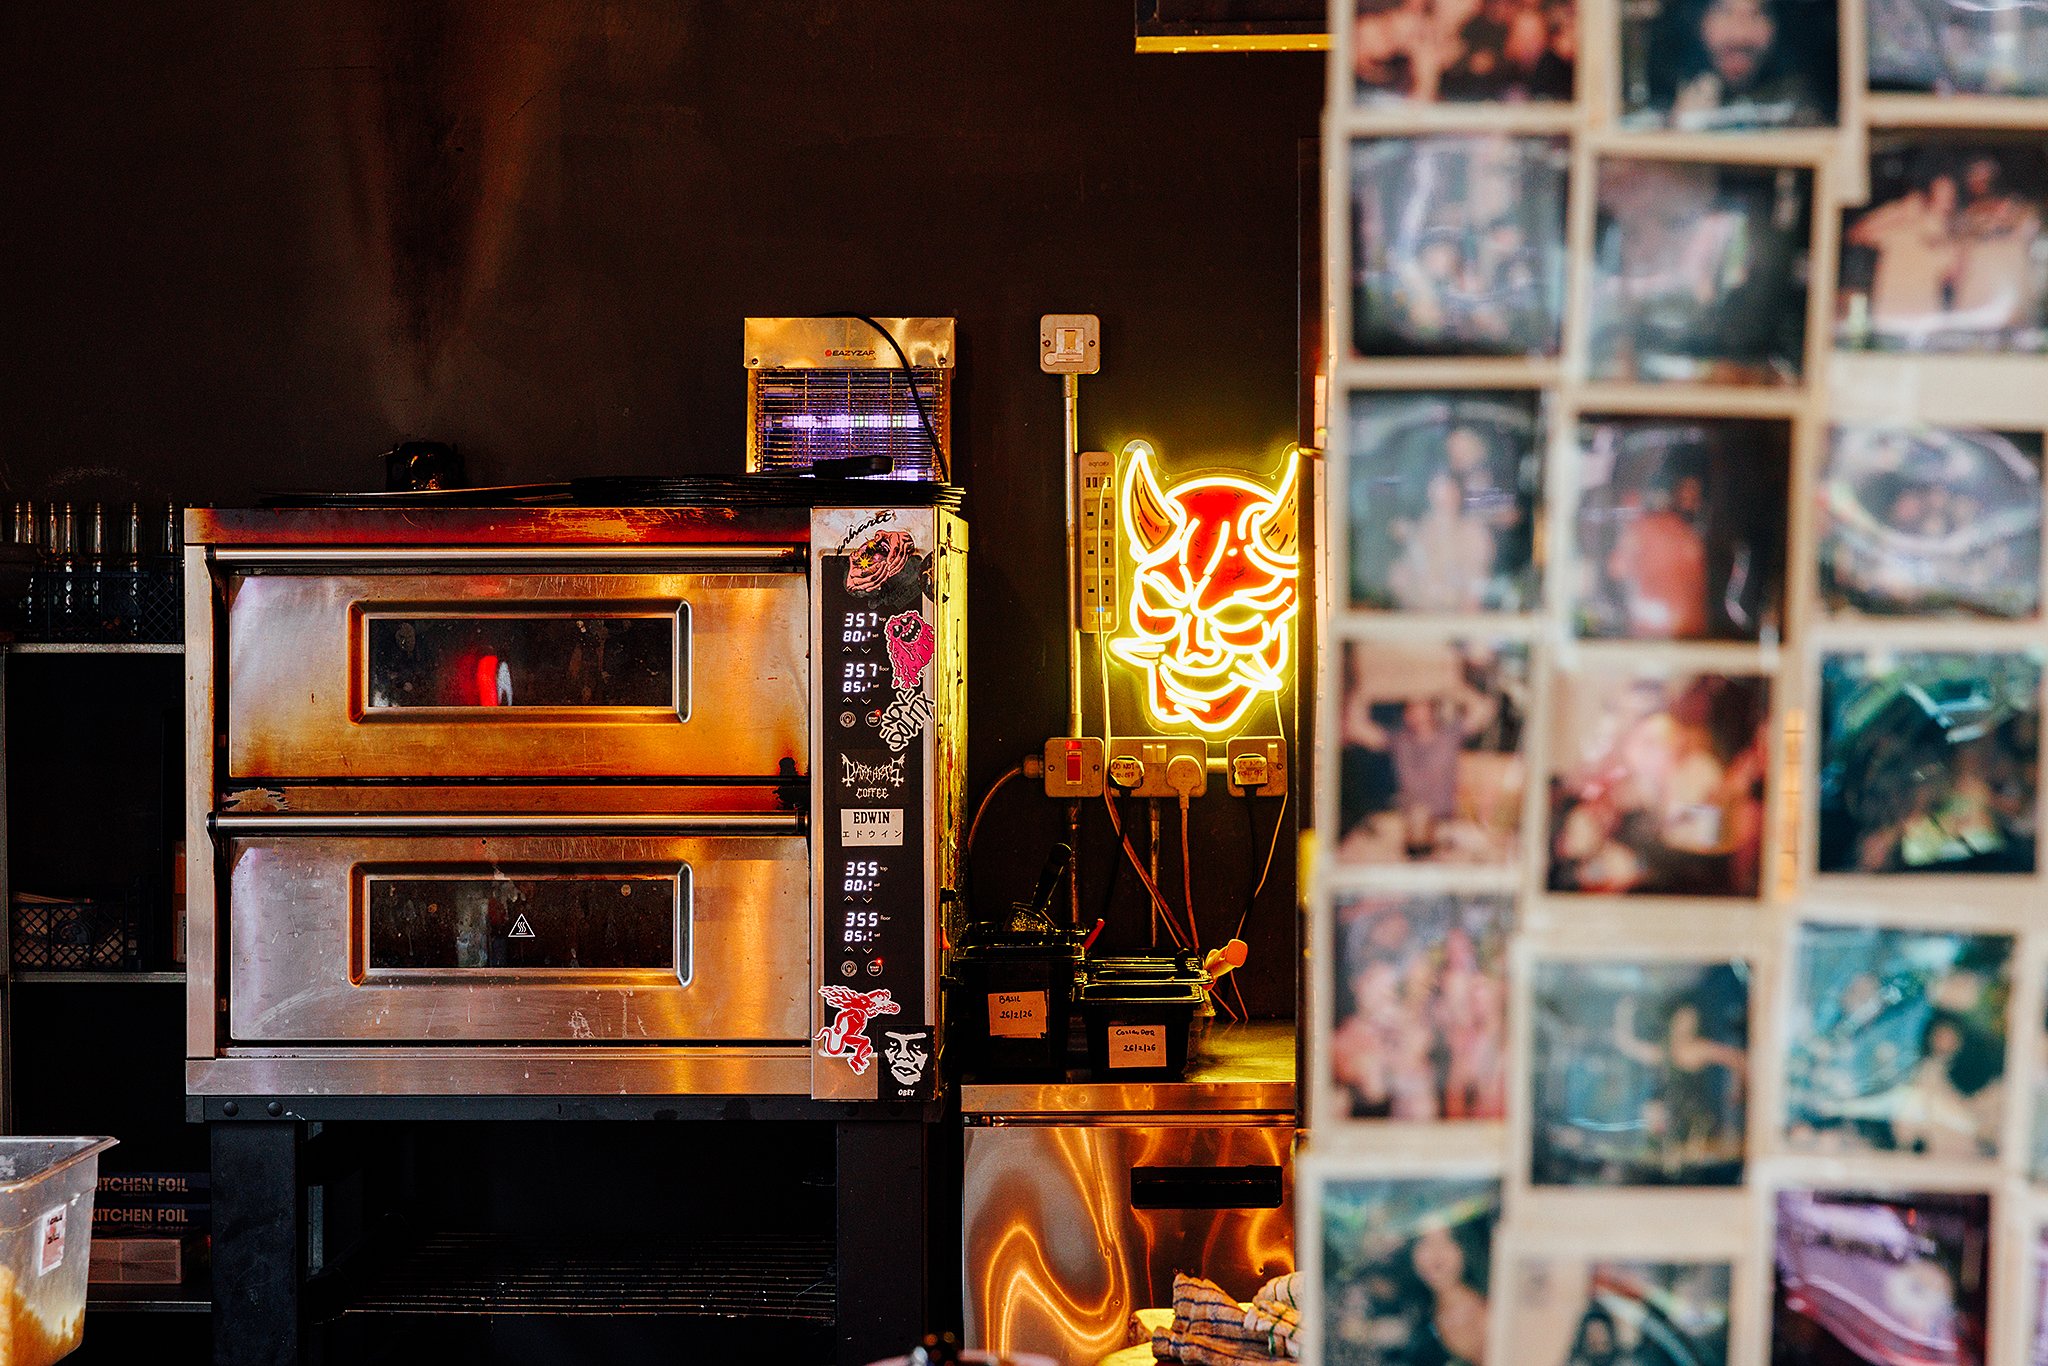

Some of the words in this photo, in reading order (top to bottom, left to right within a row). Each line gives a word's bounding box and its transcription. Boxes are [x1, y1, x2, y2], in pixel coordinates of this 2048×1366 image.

[844, 612, 878, 627] 357
[844, 663, 878, 677] 357
[853, 811, 890, 824] EDWIN
[845, 861, 878, 877] 355
[845, 912, 878, 927] 355
[1000, 1010, 1032, 1019] 26/2/26
[1123, 1044, 1156, 1052] 26/2/26
[96, 1177, 153, 1192] ITCHEN
[157, 1177, 188, 1192] FOIL
[157, 1208, 188, 1222] FOIL
